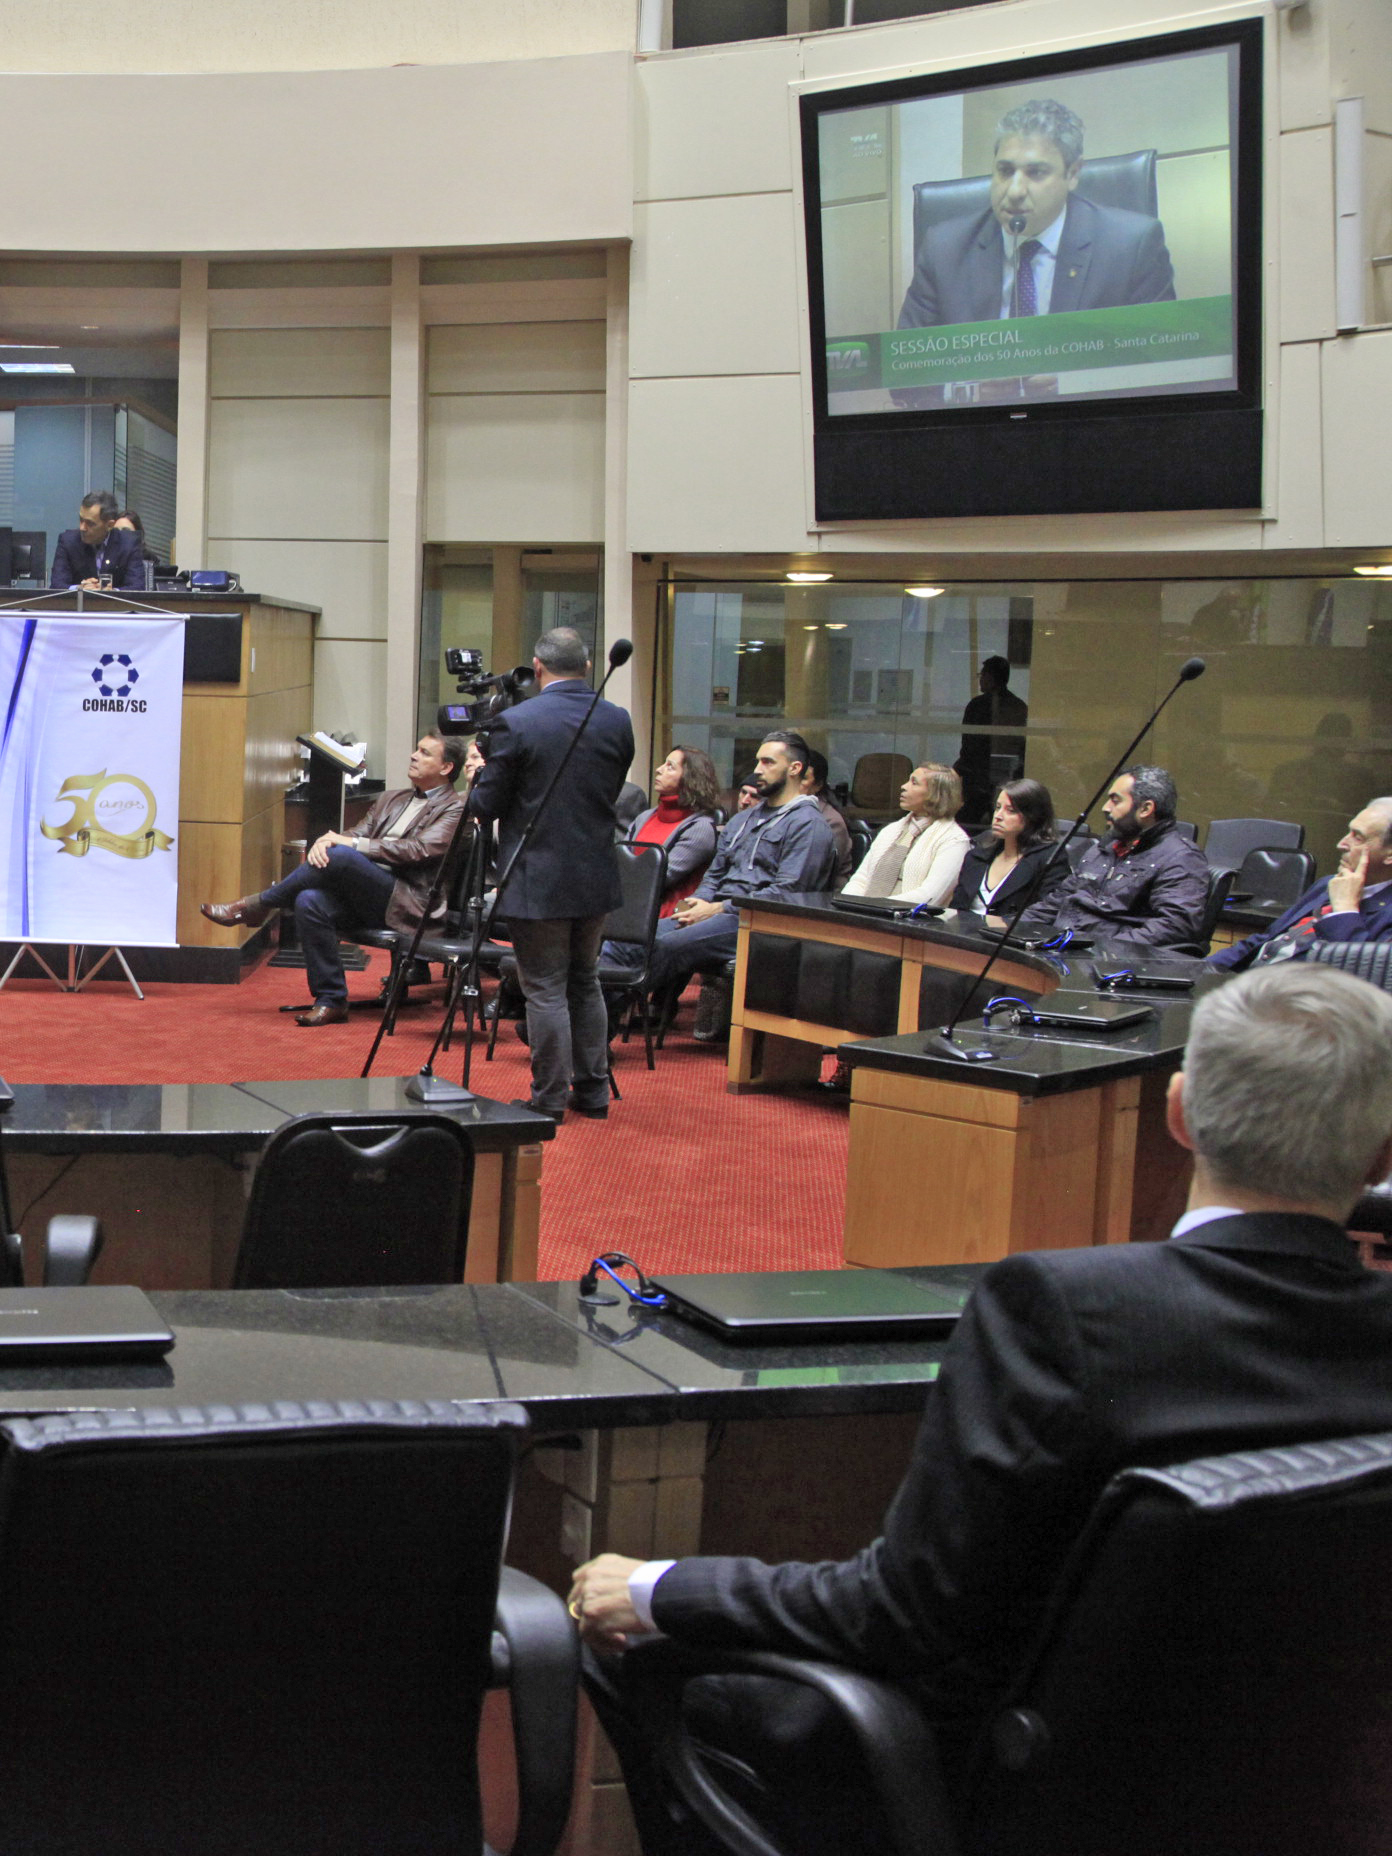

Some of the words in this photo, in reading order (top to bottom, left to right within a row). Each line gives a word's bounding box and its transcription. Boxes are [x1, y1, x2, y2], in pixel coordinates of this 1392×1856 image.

[890, 337, 948, 355] SESSÃO
[952, 330, 1023, 349] ESPECIAL
[891, 354, 971, 371] Comemoração
[974, 350, 995, 363] dos
[997, 349, 1011, 360] 50
[1013, 347, 1042, 359] Anos
[1044, 344, 1059, 356] da
[1061, 340, 1104, 354] COHAB
[1114, 336, 1147, 349] Santa
[1149, 331, 1200, 345] Catarina
[82, 698, 147, 713] COHAB/SC
